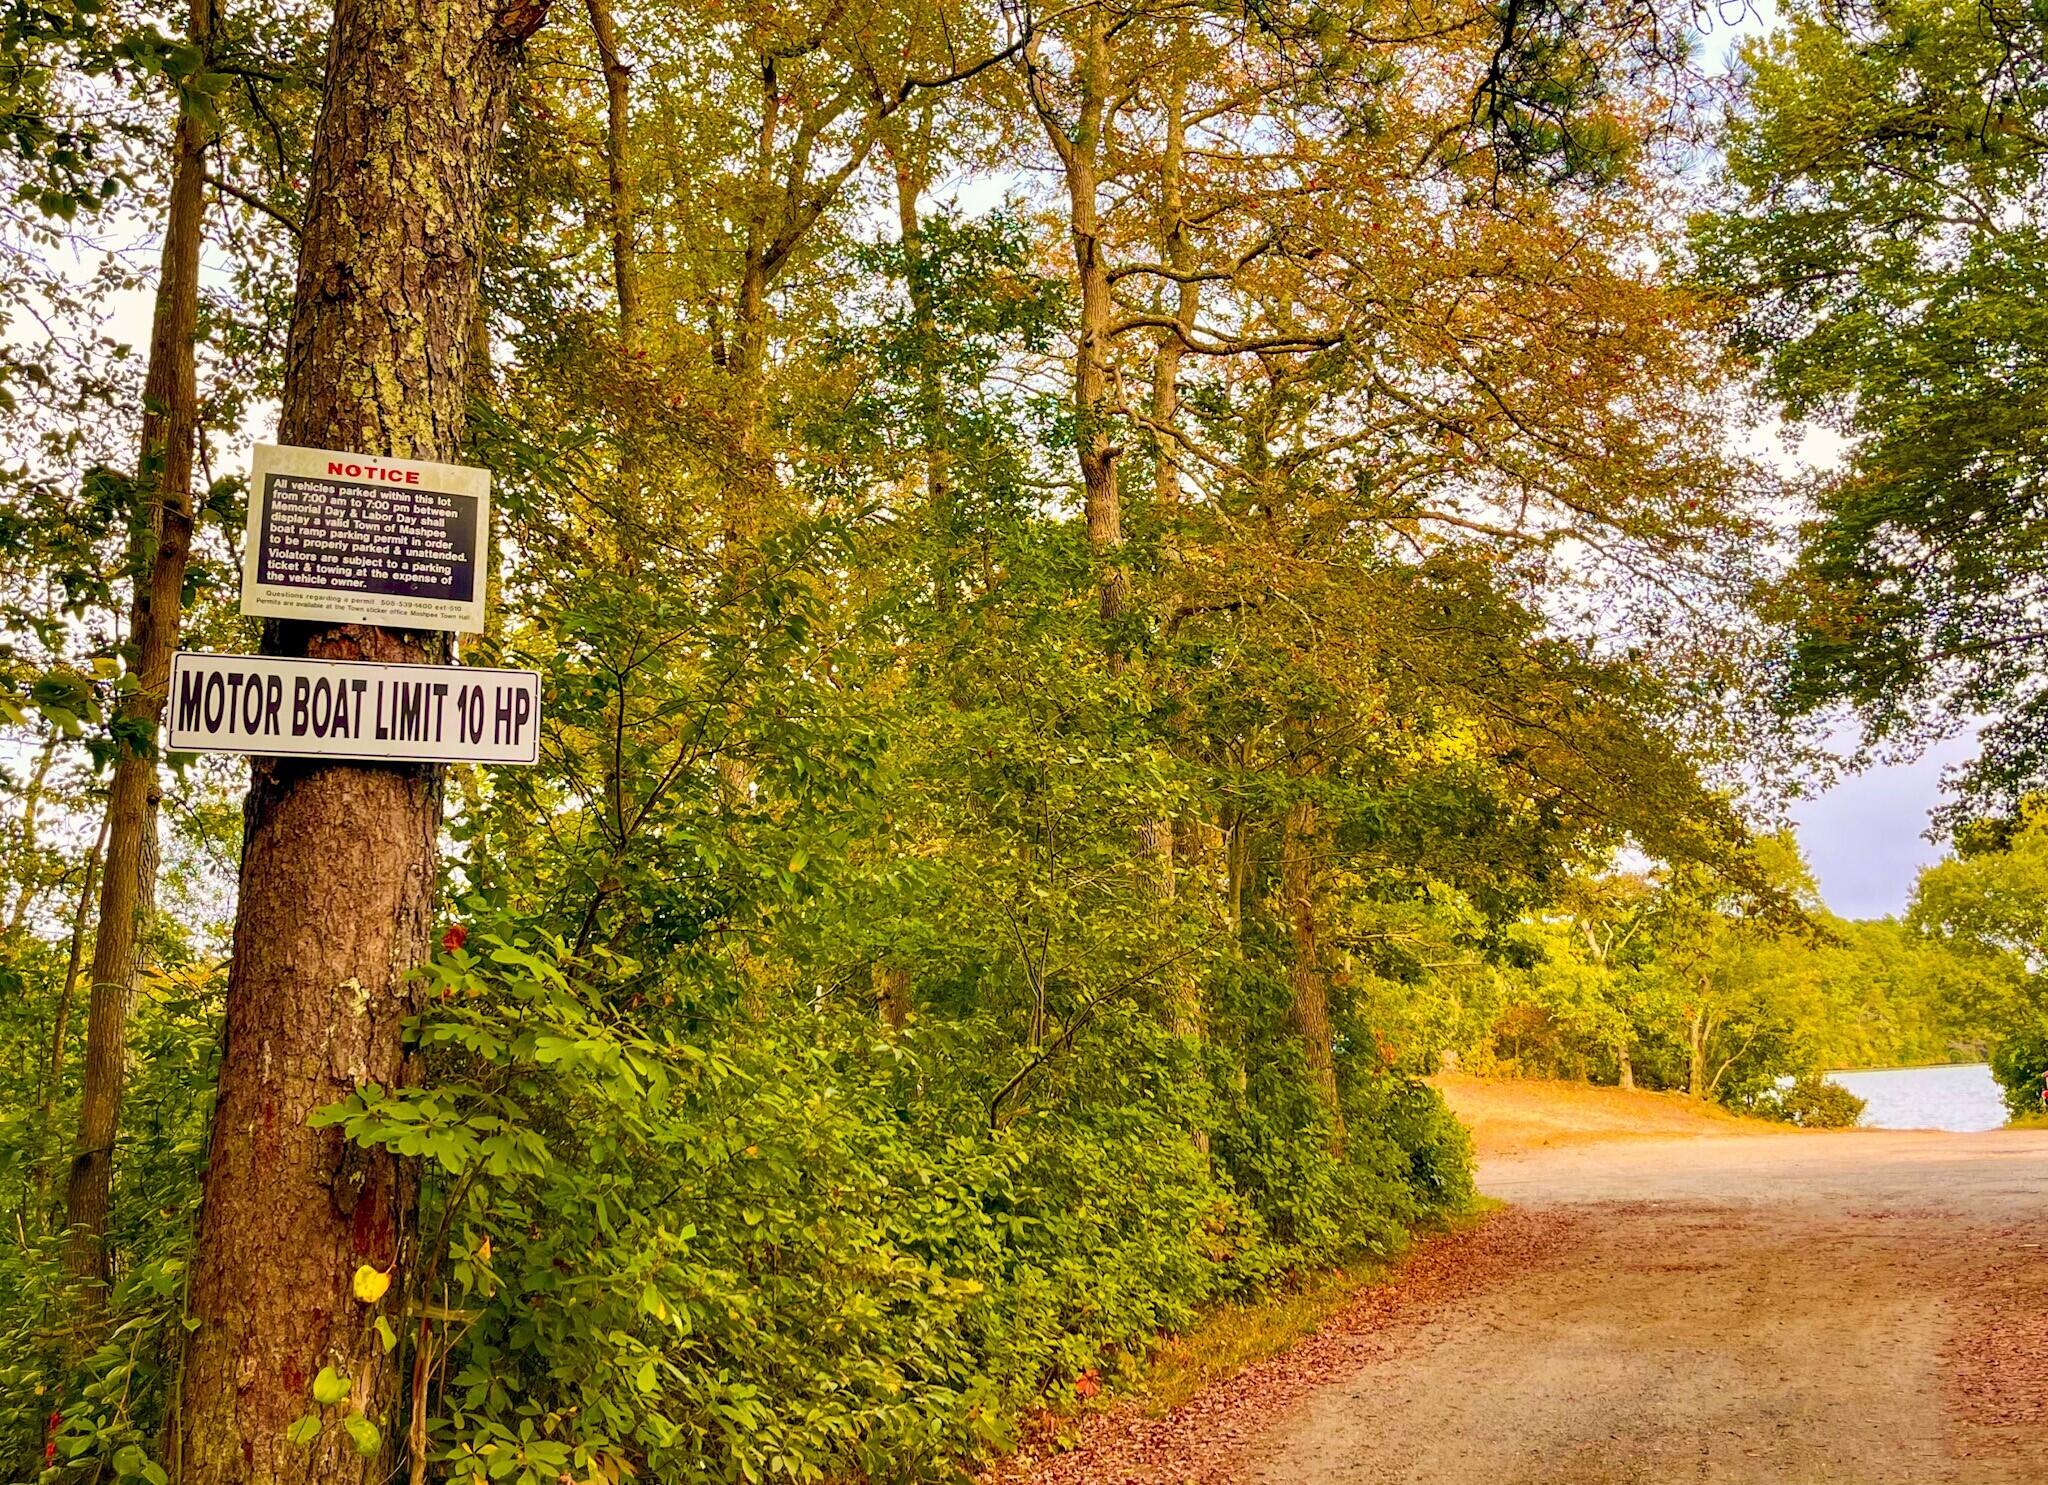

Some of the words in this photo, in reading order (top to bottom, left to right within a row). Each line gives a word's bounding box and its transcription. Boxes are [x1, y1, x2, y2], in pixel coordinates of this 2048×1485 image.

[328, 462, 420, 484] NOTICE
[273, 490, 298, 500] from
[302, 493, 326, 503] 7:00
[330, 498, 346, 506] am
[351, 498, 362, 507] to
[366, 500, 389, 510] 7:00
[393, 504, 410, 513] pm
[413, 505, 458, 518] between
[274, 479, 287, 488] All
[292, 482, 335, 493] vehicles
[339, 487, 376, 498] parked
[380, 491, 411, 502] within
[415, 494, 434, 504] this
[438, 497, 451, 506] lot
[271, 512, 310, 525] display
[325, 519, 349, 528] valid
[354, 520, 380, 531] Town
[384, 524, 396, 532] of
[400, 525, 446, 538] Mashpee
[272, 501, 321, 514] Memorial
[325, 506, 346, 517] Day
[362, 510, 393, 521] Labor
[396, 514, 417, 525] Day
[420, 517, 445, 527] shall
[270, 523, 295, 533] boat
[299, 527, 326, 537] ramp
[330, 530, 370, 542] parking
[374, 535, 408, 545] permit
[412, 537, 421, 546] in
[425, 540, 453, 550] order
[270, 535, 281, 543] to
[285, 536, 299, 545] be
[303, 539, 349, 551] properly
[352, 543, 389, 554] parked
[393, 546, 402, 555] &
[406, 549, 467, 562] unattended.
[267, 560, 299, 570] ticket
[303, 563, 312, 572] &
[317, 564, 352, 577] towing
[356, 568, 367, 577] at
[371, 569, 388, 578] the
[392, 573, 437, 583] expense
[441, 576, 453, 585] of
[268, 548, 317, 561] Violators
[321, 555, 338, 563] are
[343, 555, 382, 568] subject
[387, 559, 398, 568] to
[412, 562, 451, 575] parking
[267, 571, 285, 581] the
[289, 574, 327, 584] vehicle
[331, 578, 367, 589] owner.
[306, 594, 341, 602] regarding
[351, 596, 375, 606] permit
[348, 605, 364, 613] Town
[178, 670, 282, 735] MOTOR
[292, 676, 367, 739] BOAT
[375, 680, 448, 742] LIMIT
[457, 684, 484, 744] 10
[494, 686, 530, 746] HP
